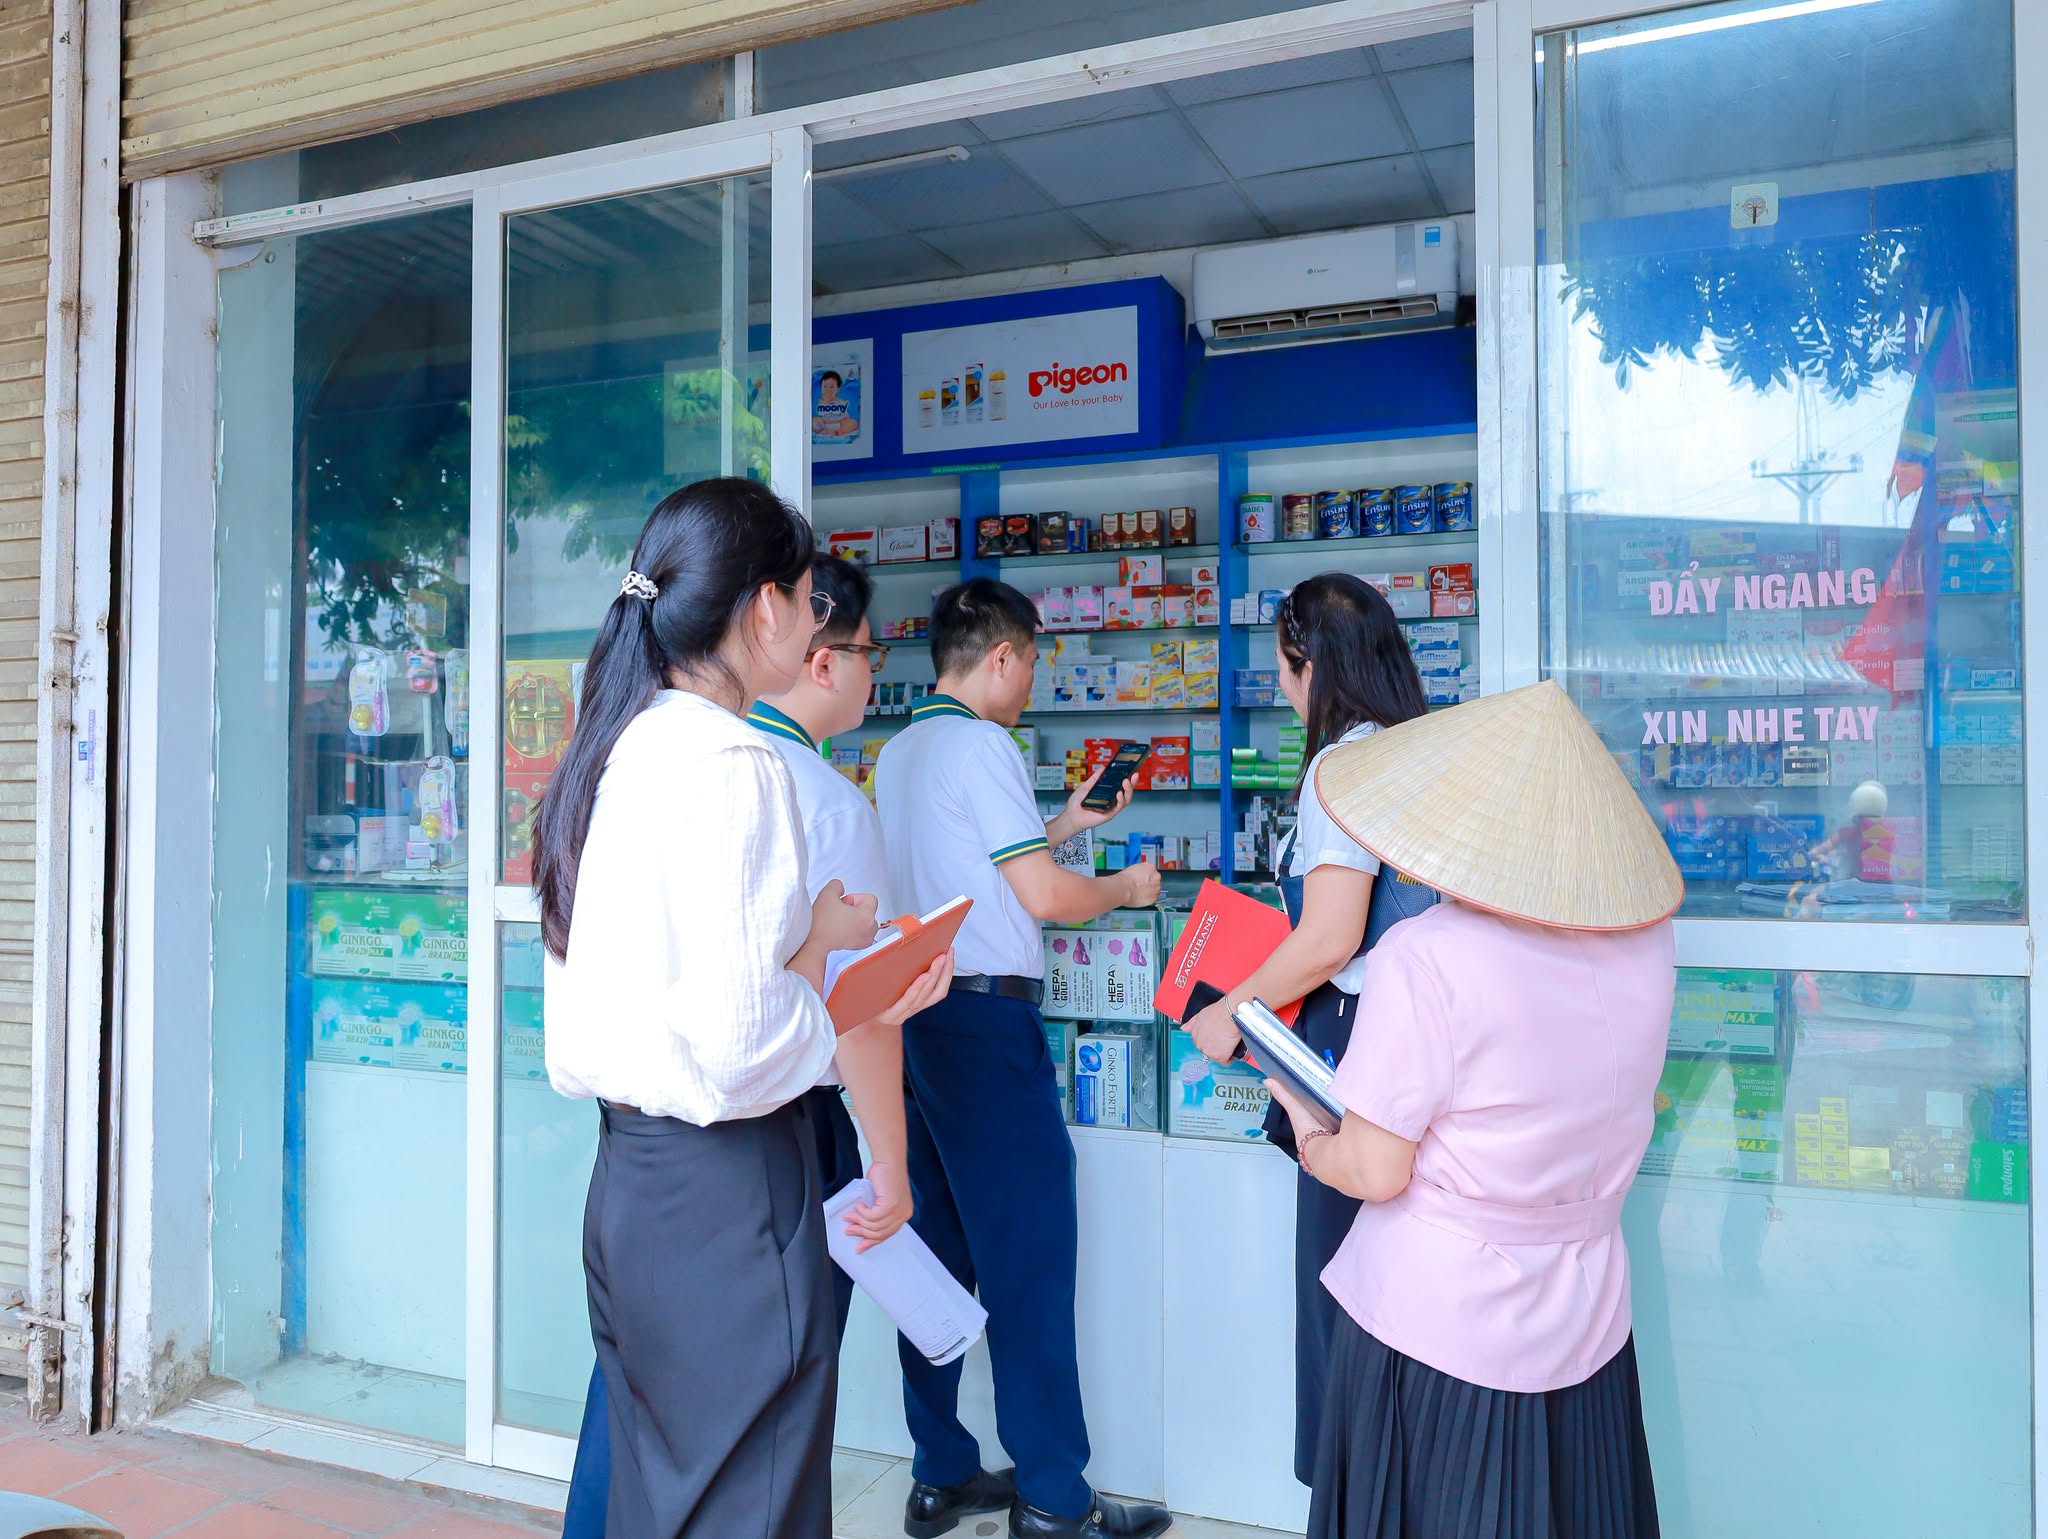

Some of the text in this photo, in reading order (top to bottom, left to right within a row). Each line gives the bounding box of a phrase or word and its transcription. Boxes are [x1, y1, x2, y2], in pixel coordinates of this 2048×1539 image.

[817, 402, 849, 414] moony
[1033, 394, 1124, 410] Our Love to your Baby
[1320, 504, 1349, 519] Ensure
[1402, 500, 1430, 513] Ensure
[1437, 497, 1465, 511] Ensure
[1649, 561, 1877, 616] ĐẨY NGANG
[1642, 704, 1879, 752] XIN NHẸ TAY
[340, 934, 382, 947] GINKGO
[422, 938, 467, 951] GINKGO
[1184, 913, 1217, 976] AGRIBANK
[428, 951, 452, 960] BRAIN
[1052, 967, 1060, 1001] HEPA
[1060, 980, 1068, 1002] GOLD
[1108, 969, 1116, 1004] HEPA
[1116, 982, 1124, 1003] GOLD
[1724, 1011, 1759, 1026] MAX
[340, 1022, 382, 1035] GINKGO
[421, 1027, 465, 1041] GINKGO
[427, 1040, 451, 1049] BRAIN
[1107, 1047, 1117, 1119] GINKO FORTE
[1214, 1083, 1271, 1101] GINKG
[1223, 1101, 1261, 1113] BRAIN
[1735, 1139, 1769, 1152] MAX
[2000, 1148, 2015, 1197] Salonpas
